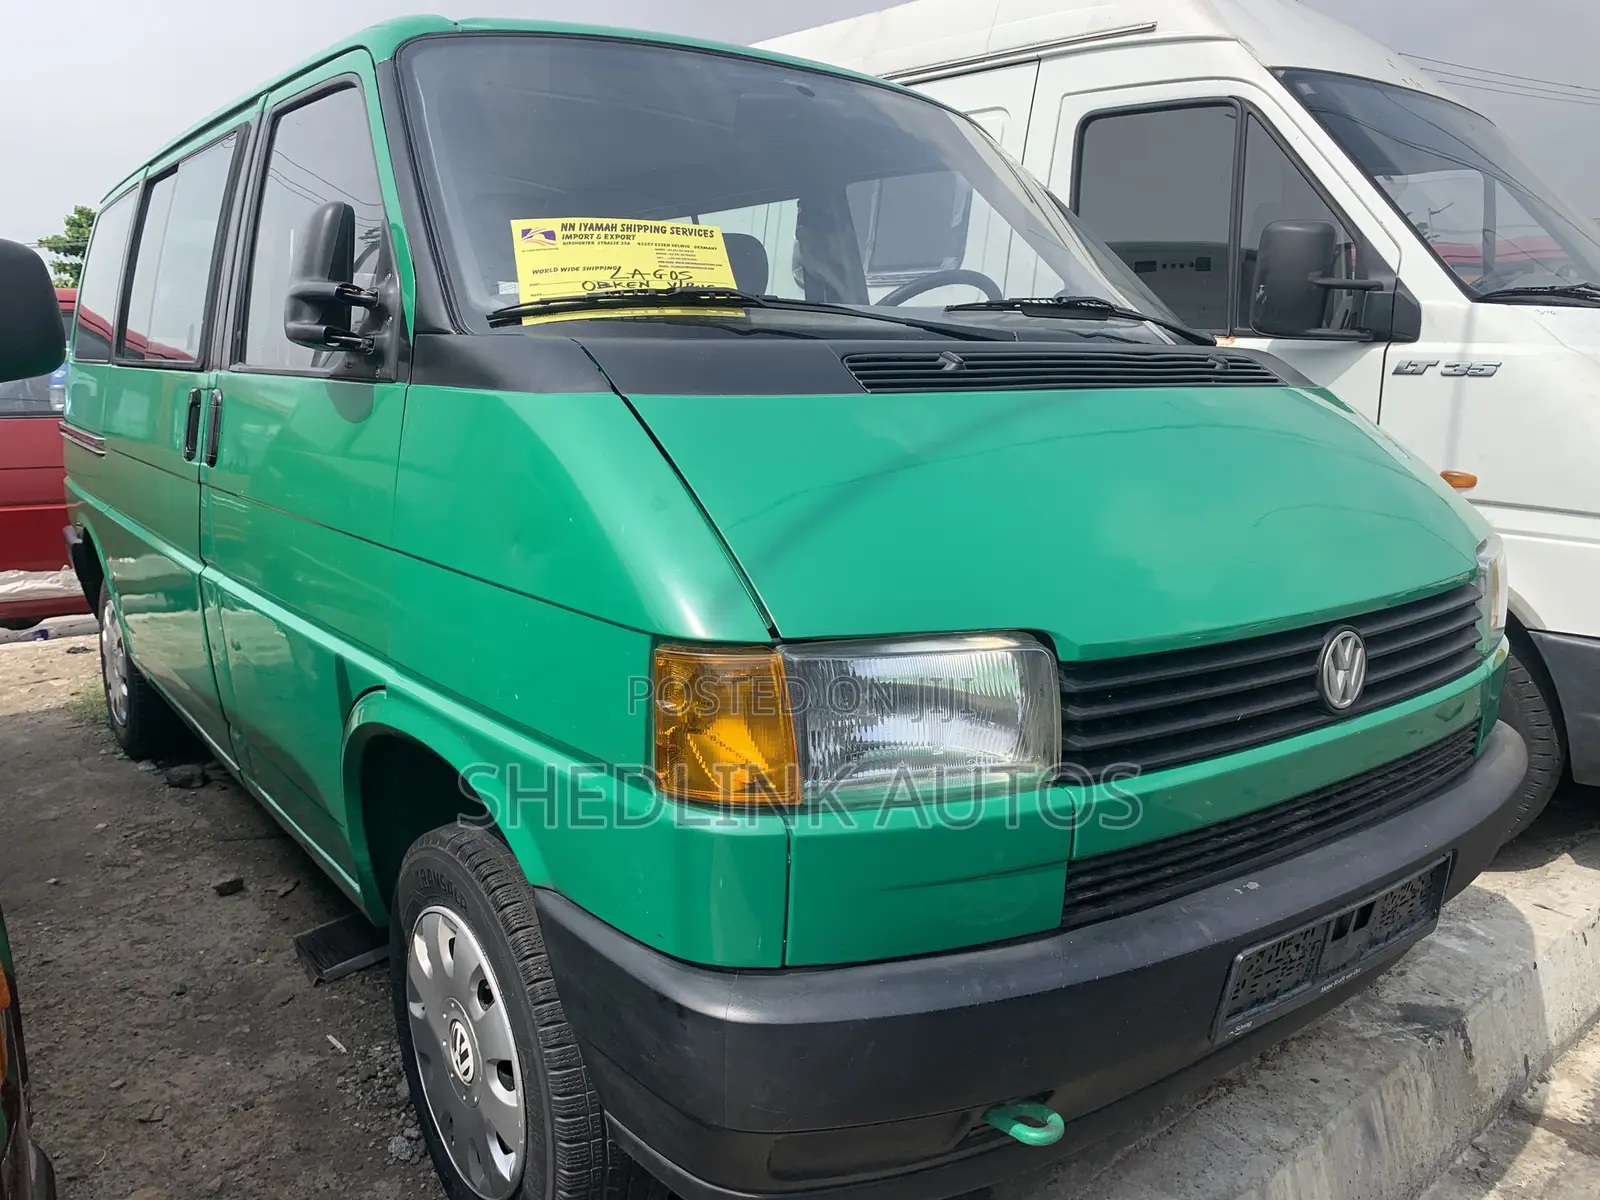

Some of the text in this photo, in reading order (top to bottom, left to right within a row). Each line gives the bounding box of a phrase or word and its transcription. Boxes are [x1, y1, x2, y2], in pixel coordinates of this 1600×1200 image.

[560, 222, 715, 238] NN IYAMAH SHIPPING SERVICES
[532, 266, 558, 275] WORLD
[610, 265, 693, 280] LAGOS
[1391, 360, 1503, 377] LT 35
